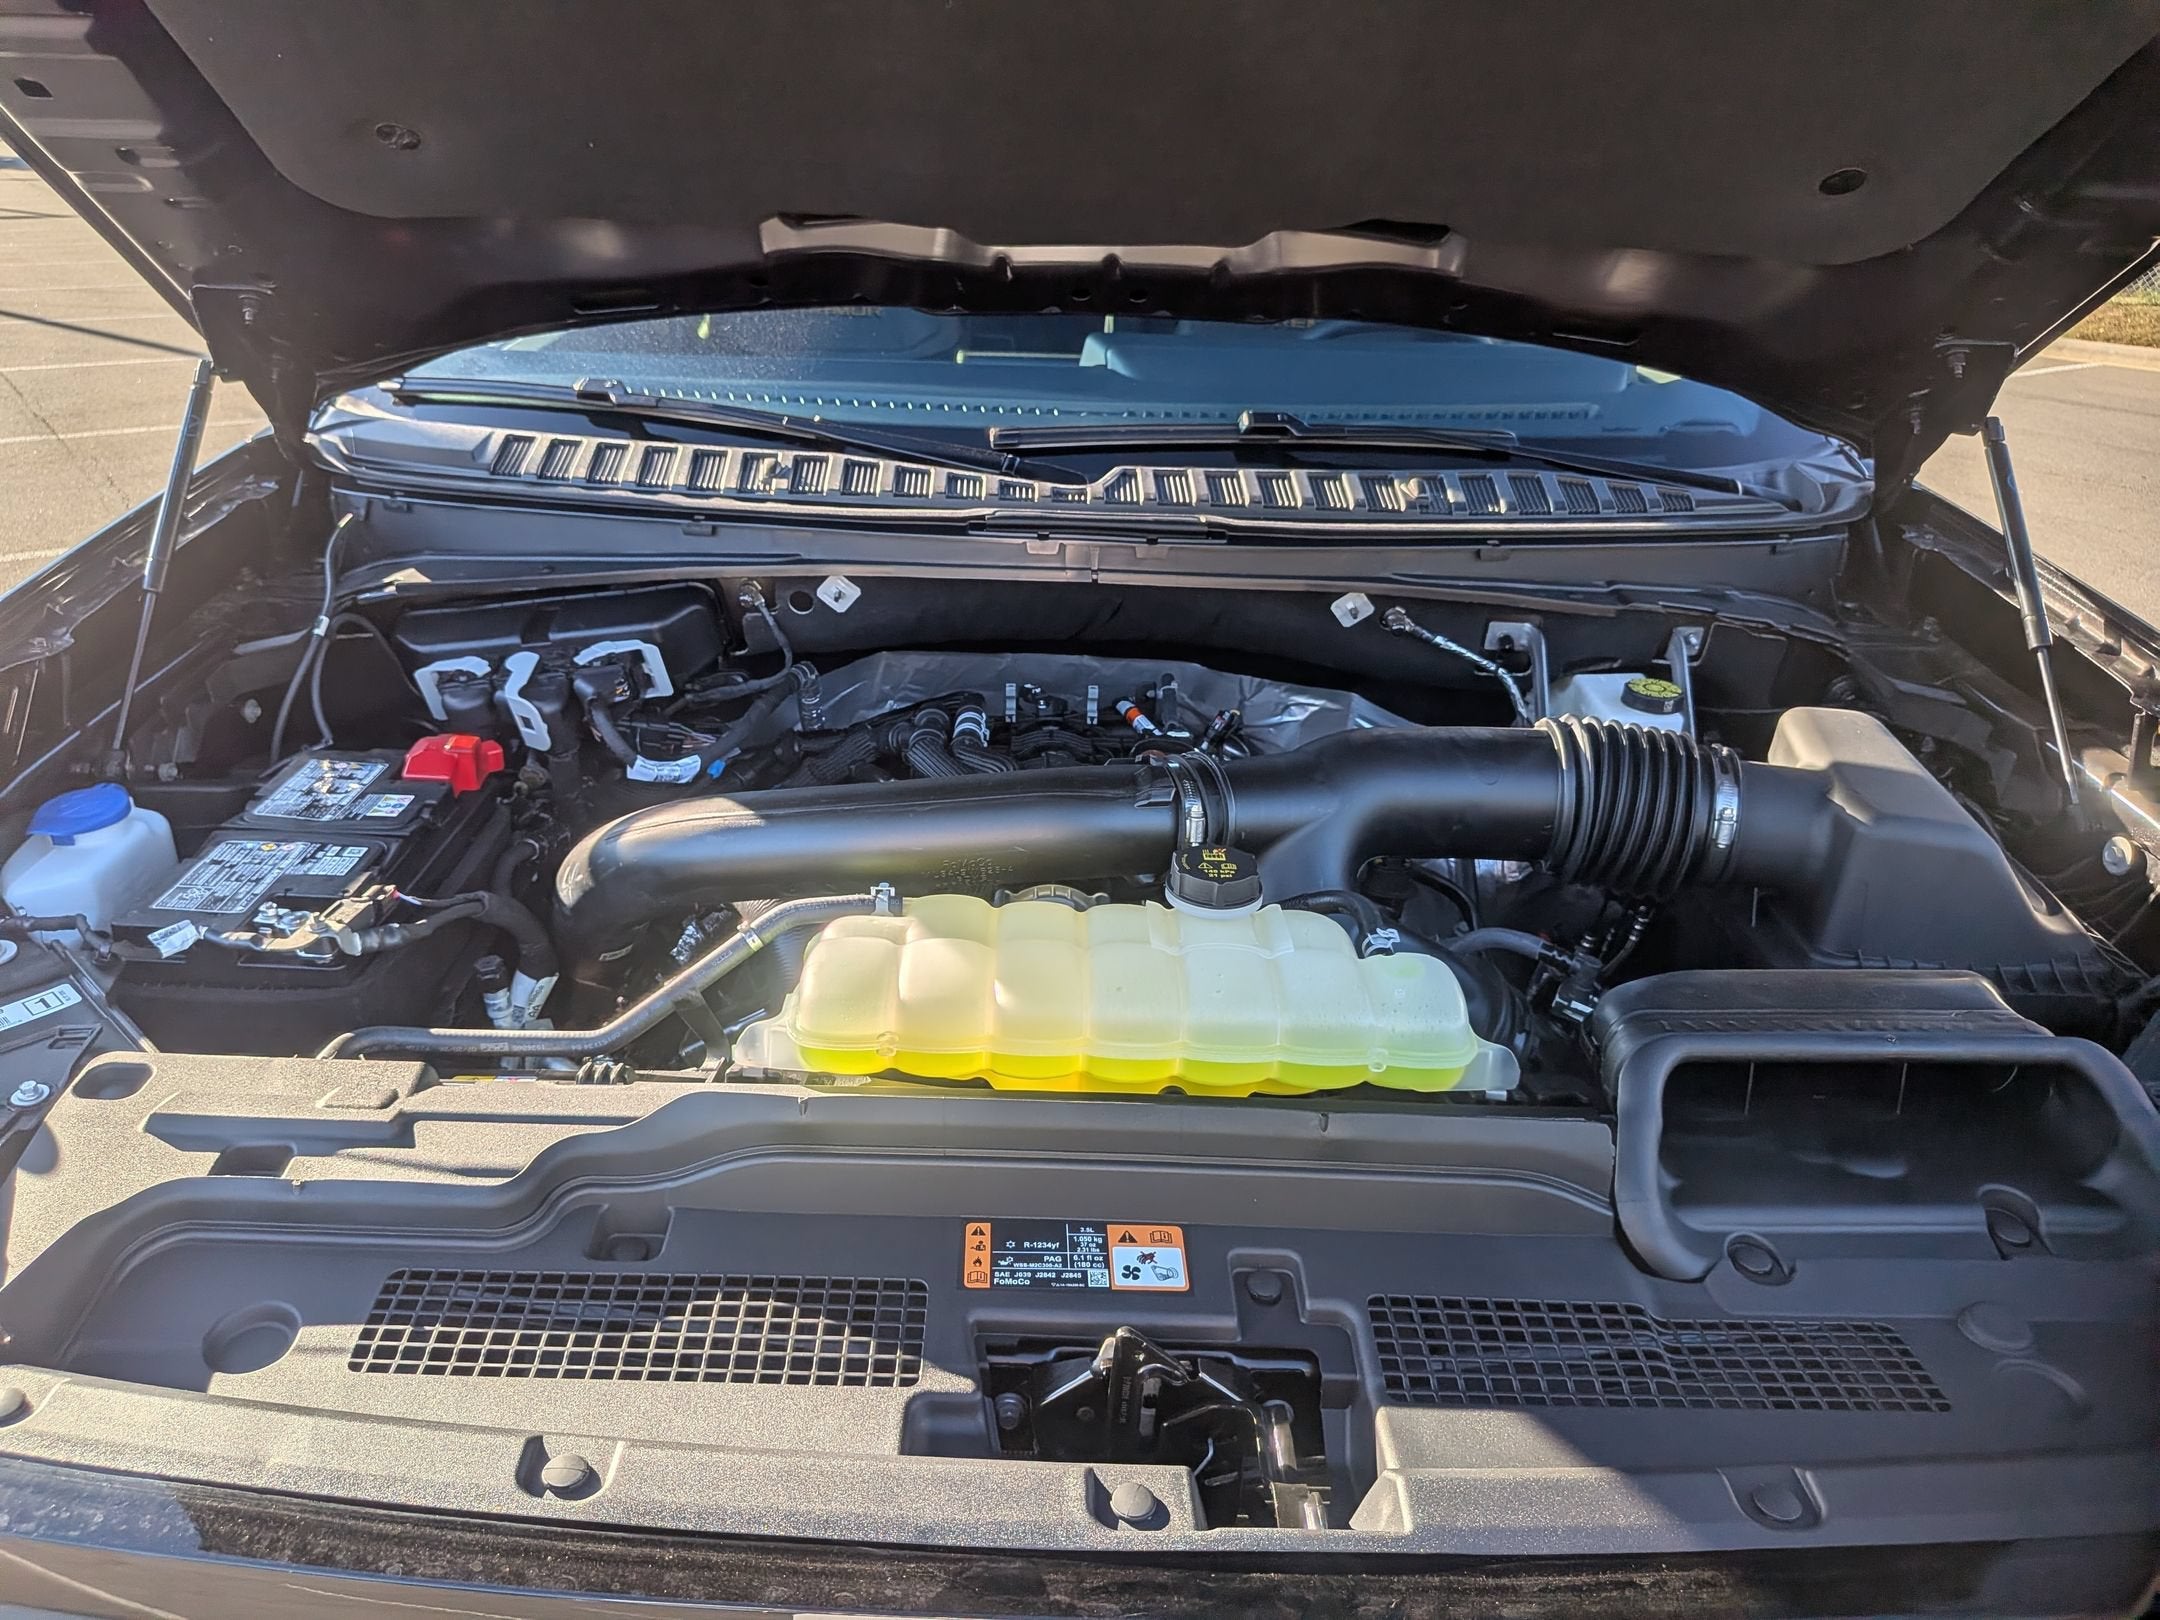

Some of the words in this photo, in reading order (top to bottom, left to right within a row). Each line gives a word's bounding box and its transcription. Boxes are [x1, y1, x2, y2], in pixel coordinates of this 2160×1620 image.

[34, 997, 52, 1009] 1
[1023, 1241, 1060, 1250] R-1234yf
[1043, 1255, 1062, 1263] PAG
[1092, 1261, 1105, 1269] cc)
[993, 1278, 1031, 1286] FoMoCo
